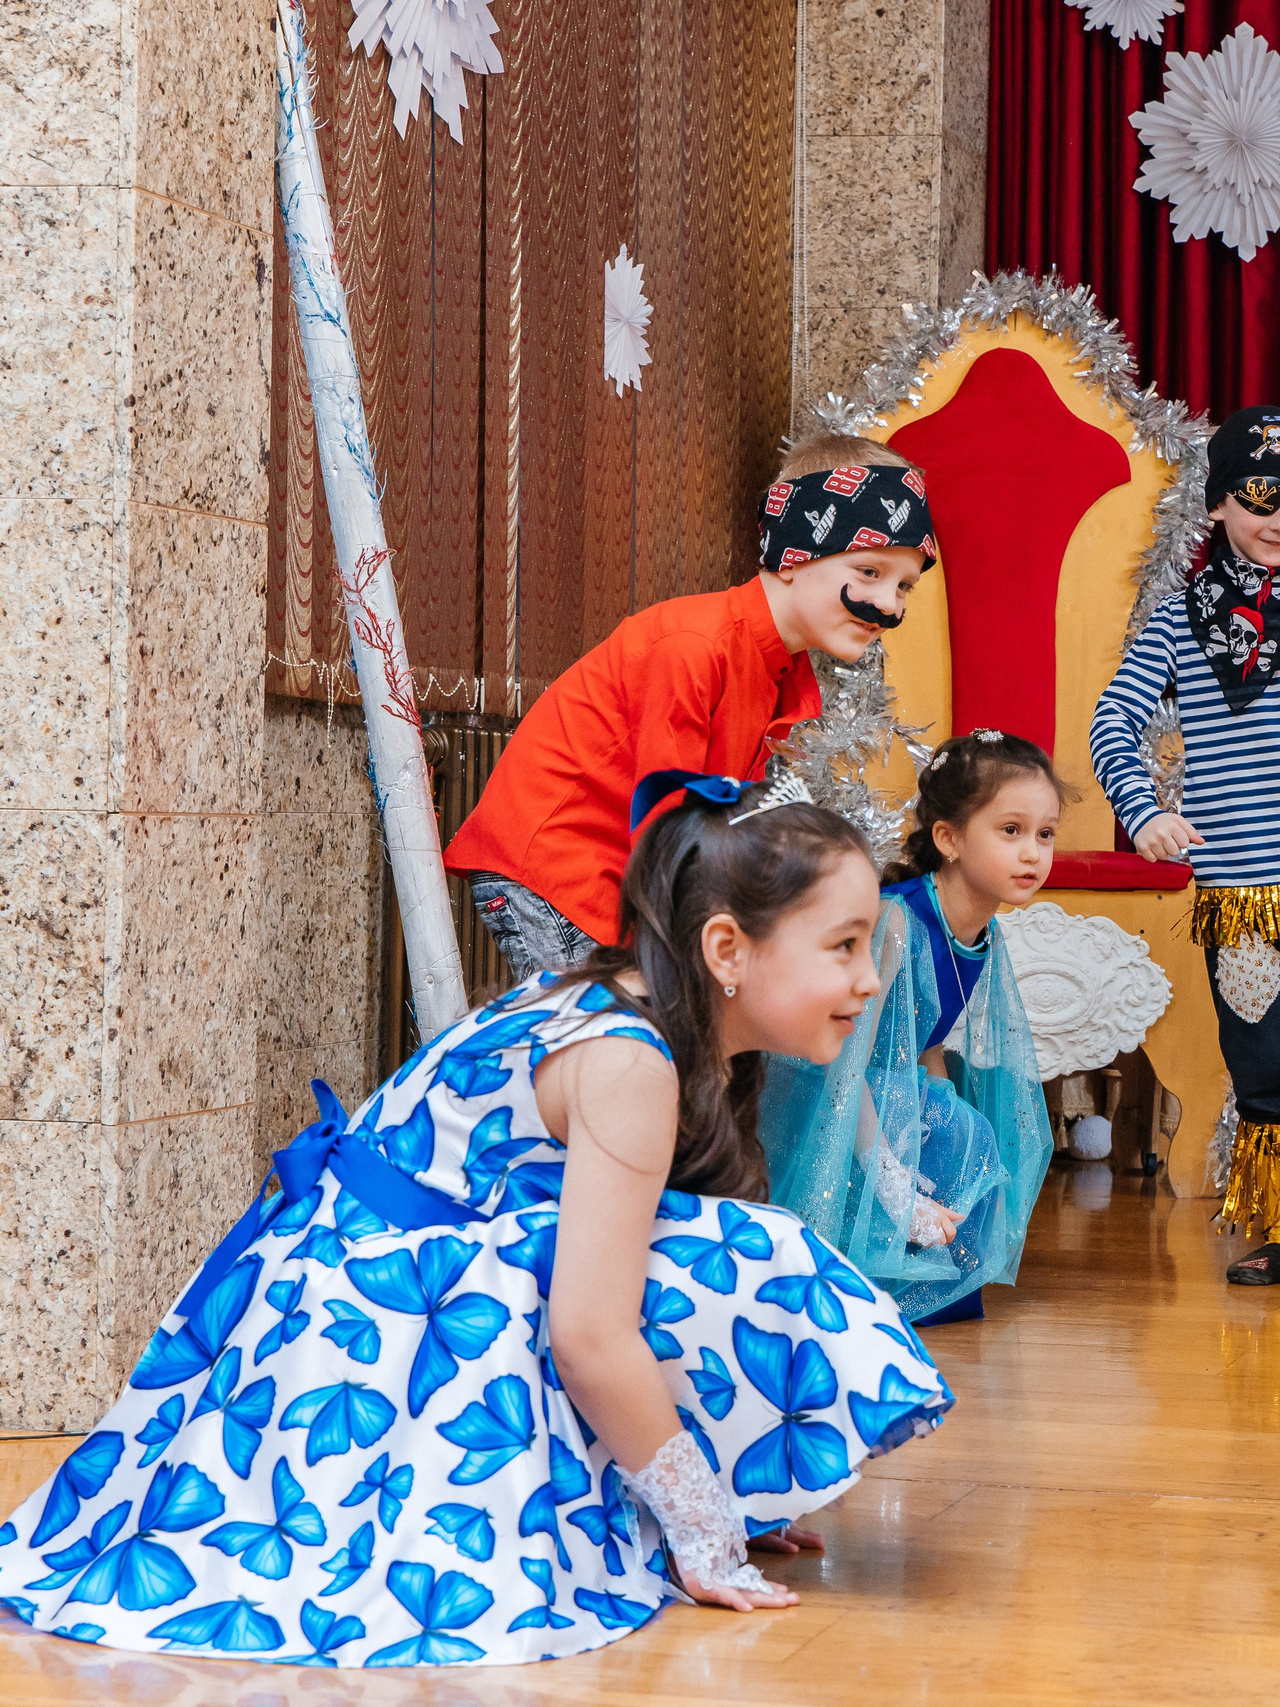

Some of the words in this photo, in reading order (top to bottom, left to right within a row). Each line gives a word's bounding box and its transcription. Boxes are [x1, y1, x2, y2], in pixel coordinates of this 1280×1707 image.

[823, 466, 870, 497] 88
[765, 482, 794, 517] 88
[845, 526, 890, 551] 8
[779, 547, 812, 572] 8
